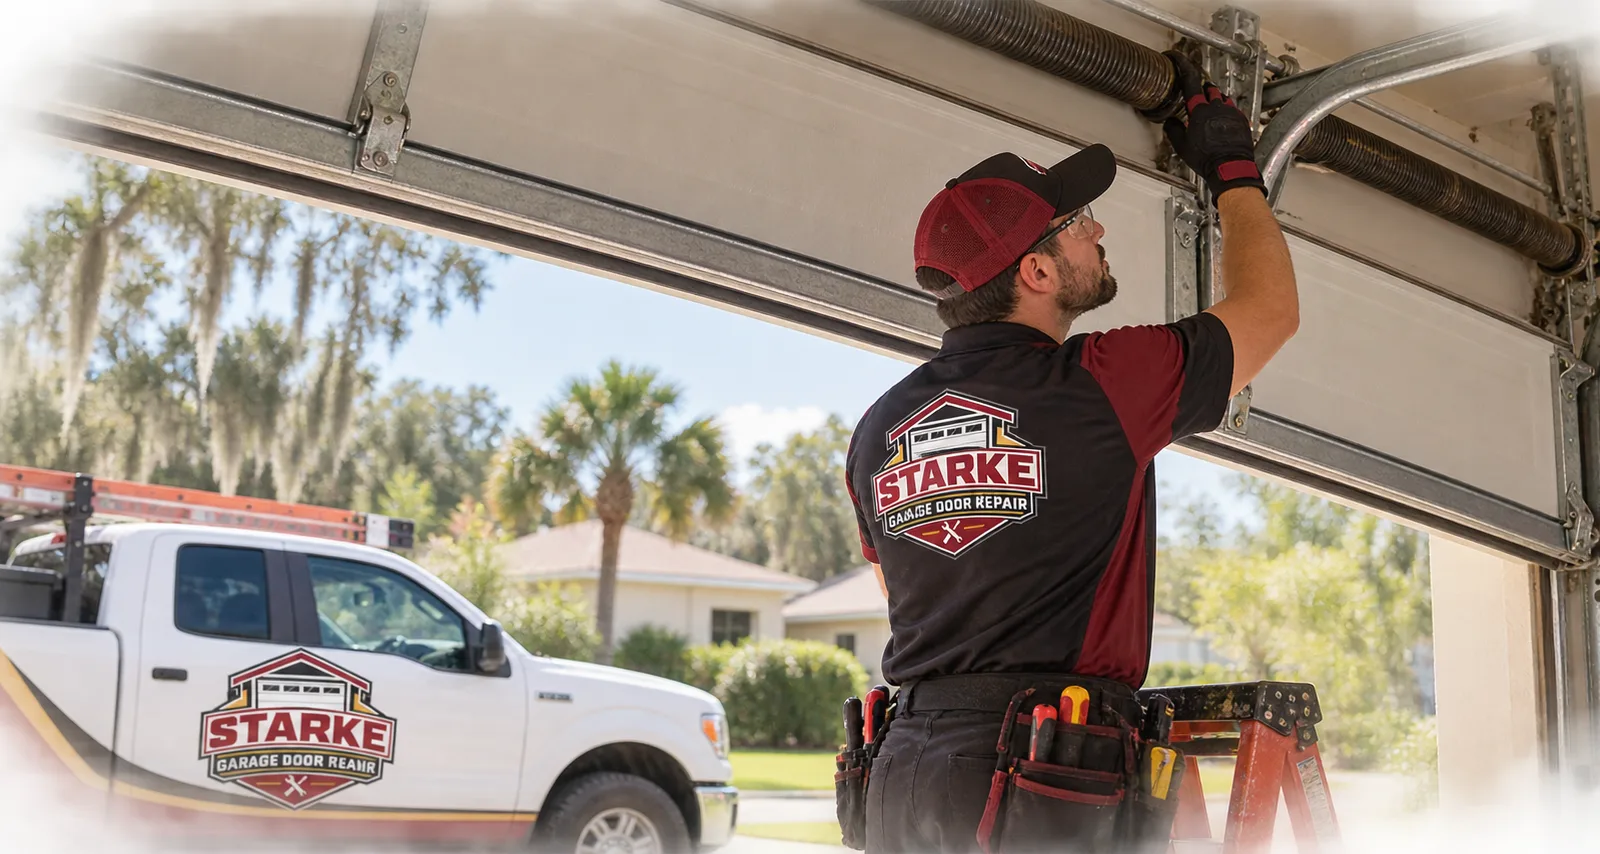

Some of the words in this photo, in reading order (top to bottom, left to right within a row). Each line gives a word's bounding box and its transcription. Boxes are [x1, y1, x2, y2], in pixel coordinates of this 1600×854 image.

[878, 453, 1036, 507] STARKE
[936, 497, 972, 513] DOOR
[975, 496, 1027, 510] REPAIR
[209, 712, 388, 752] STARKE
[216, 754, 279, 772] GARAGE
[282, 754, 324, 768] DOOR
